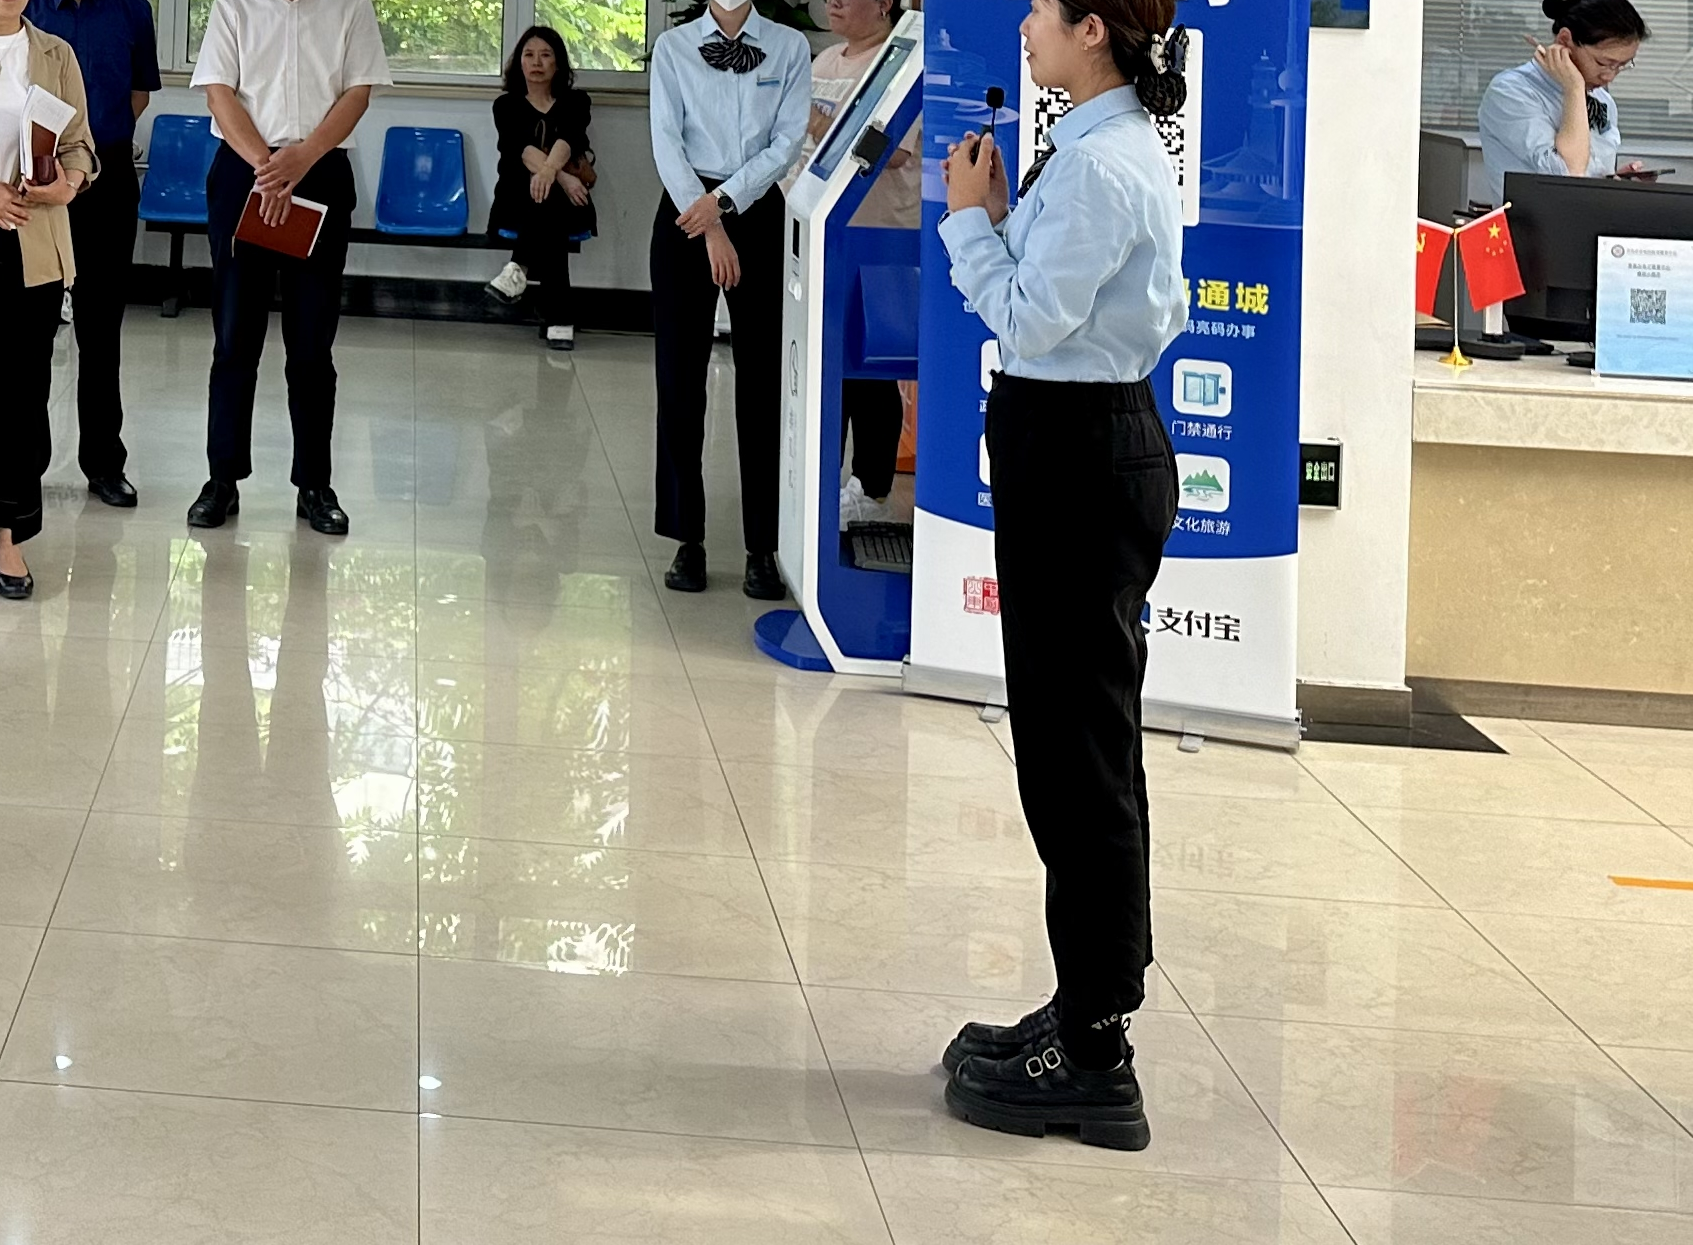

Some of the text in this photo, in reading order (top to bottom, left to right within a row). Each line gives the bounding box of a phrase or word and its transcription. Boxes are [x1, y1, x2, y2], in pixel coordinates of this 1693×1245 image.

[1171, 420, 1232, 440] 门禁通行
[1306, 461, 1335, 482] 安全出口
[1172, 516, 1230, 536] 文化旅游
[1156, 607, 1240, 642] 支付宝
